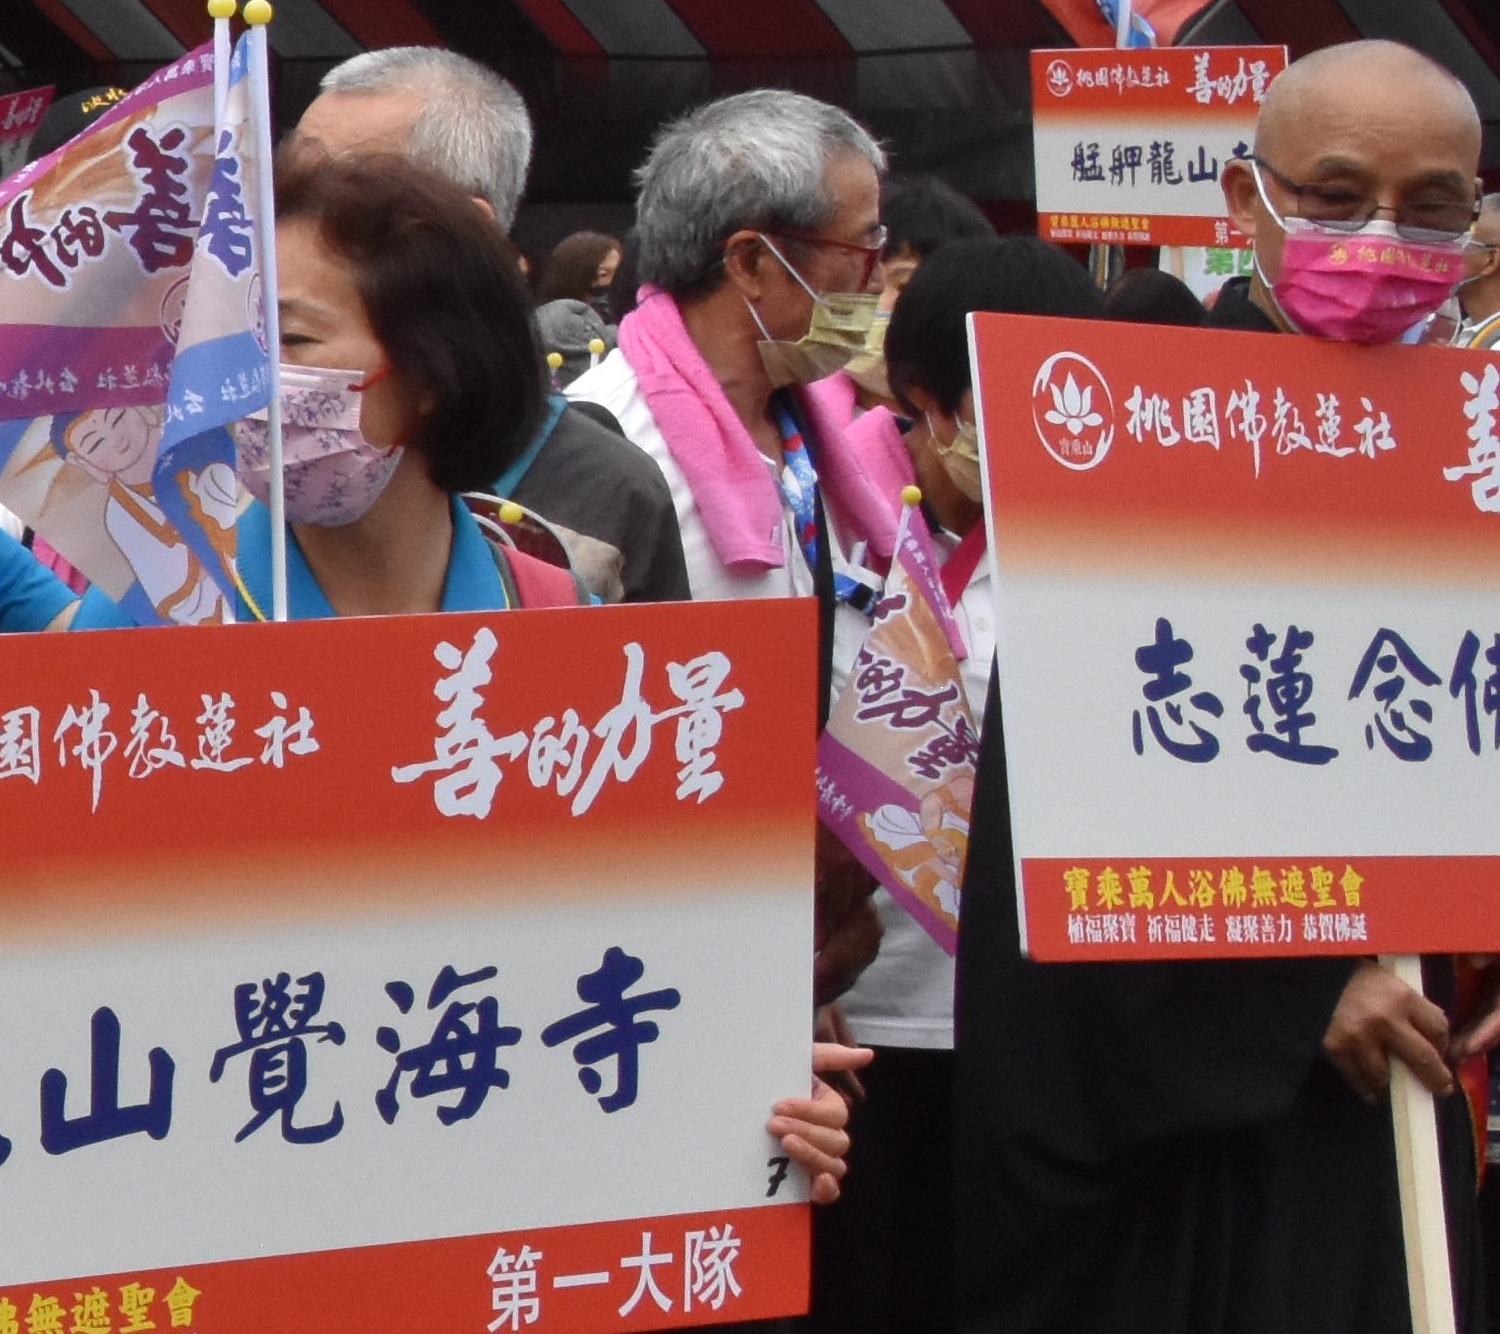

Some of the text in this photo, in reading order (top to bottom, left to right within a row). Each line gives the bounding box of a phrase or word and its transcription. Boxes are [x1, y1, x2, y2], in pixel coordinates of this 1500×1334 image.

[1186, 52, 1269, 104] 善的力量
[1215, 221, 1254, 244] 第一
[1124, 378, 1397, 479] 桃園佛教蓮社
[392, 626, 746, 823] 善的力量
[1063, 865, 1366, 913] 寶乘萬人浴佛無遮聖會
[1067, 913, 1368, 945] 植福聚寶 祈福健走 凝聚善力 恭賀佛誕
[486, 1223, 745, 1334] 第一大隊
